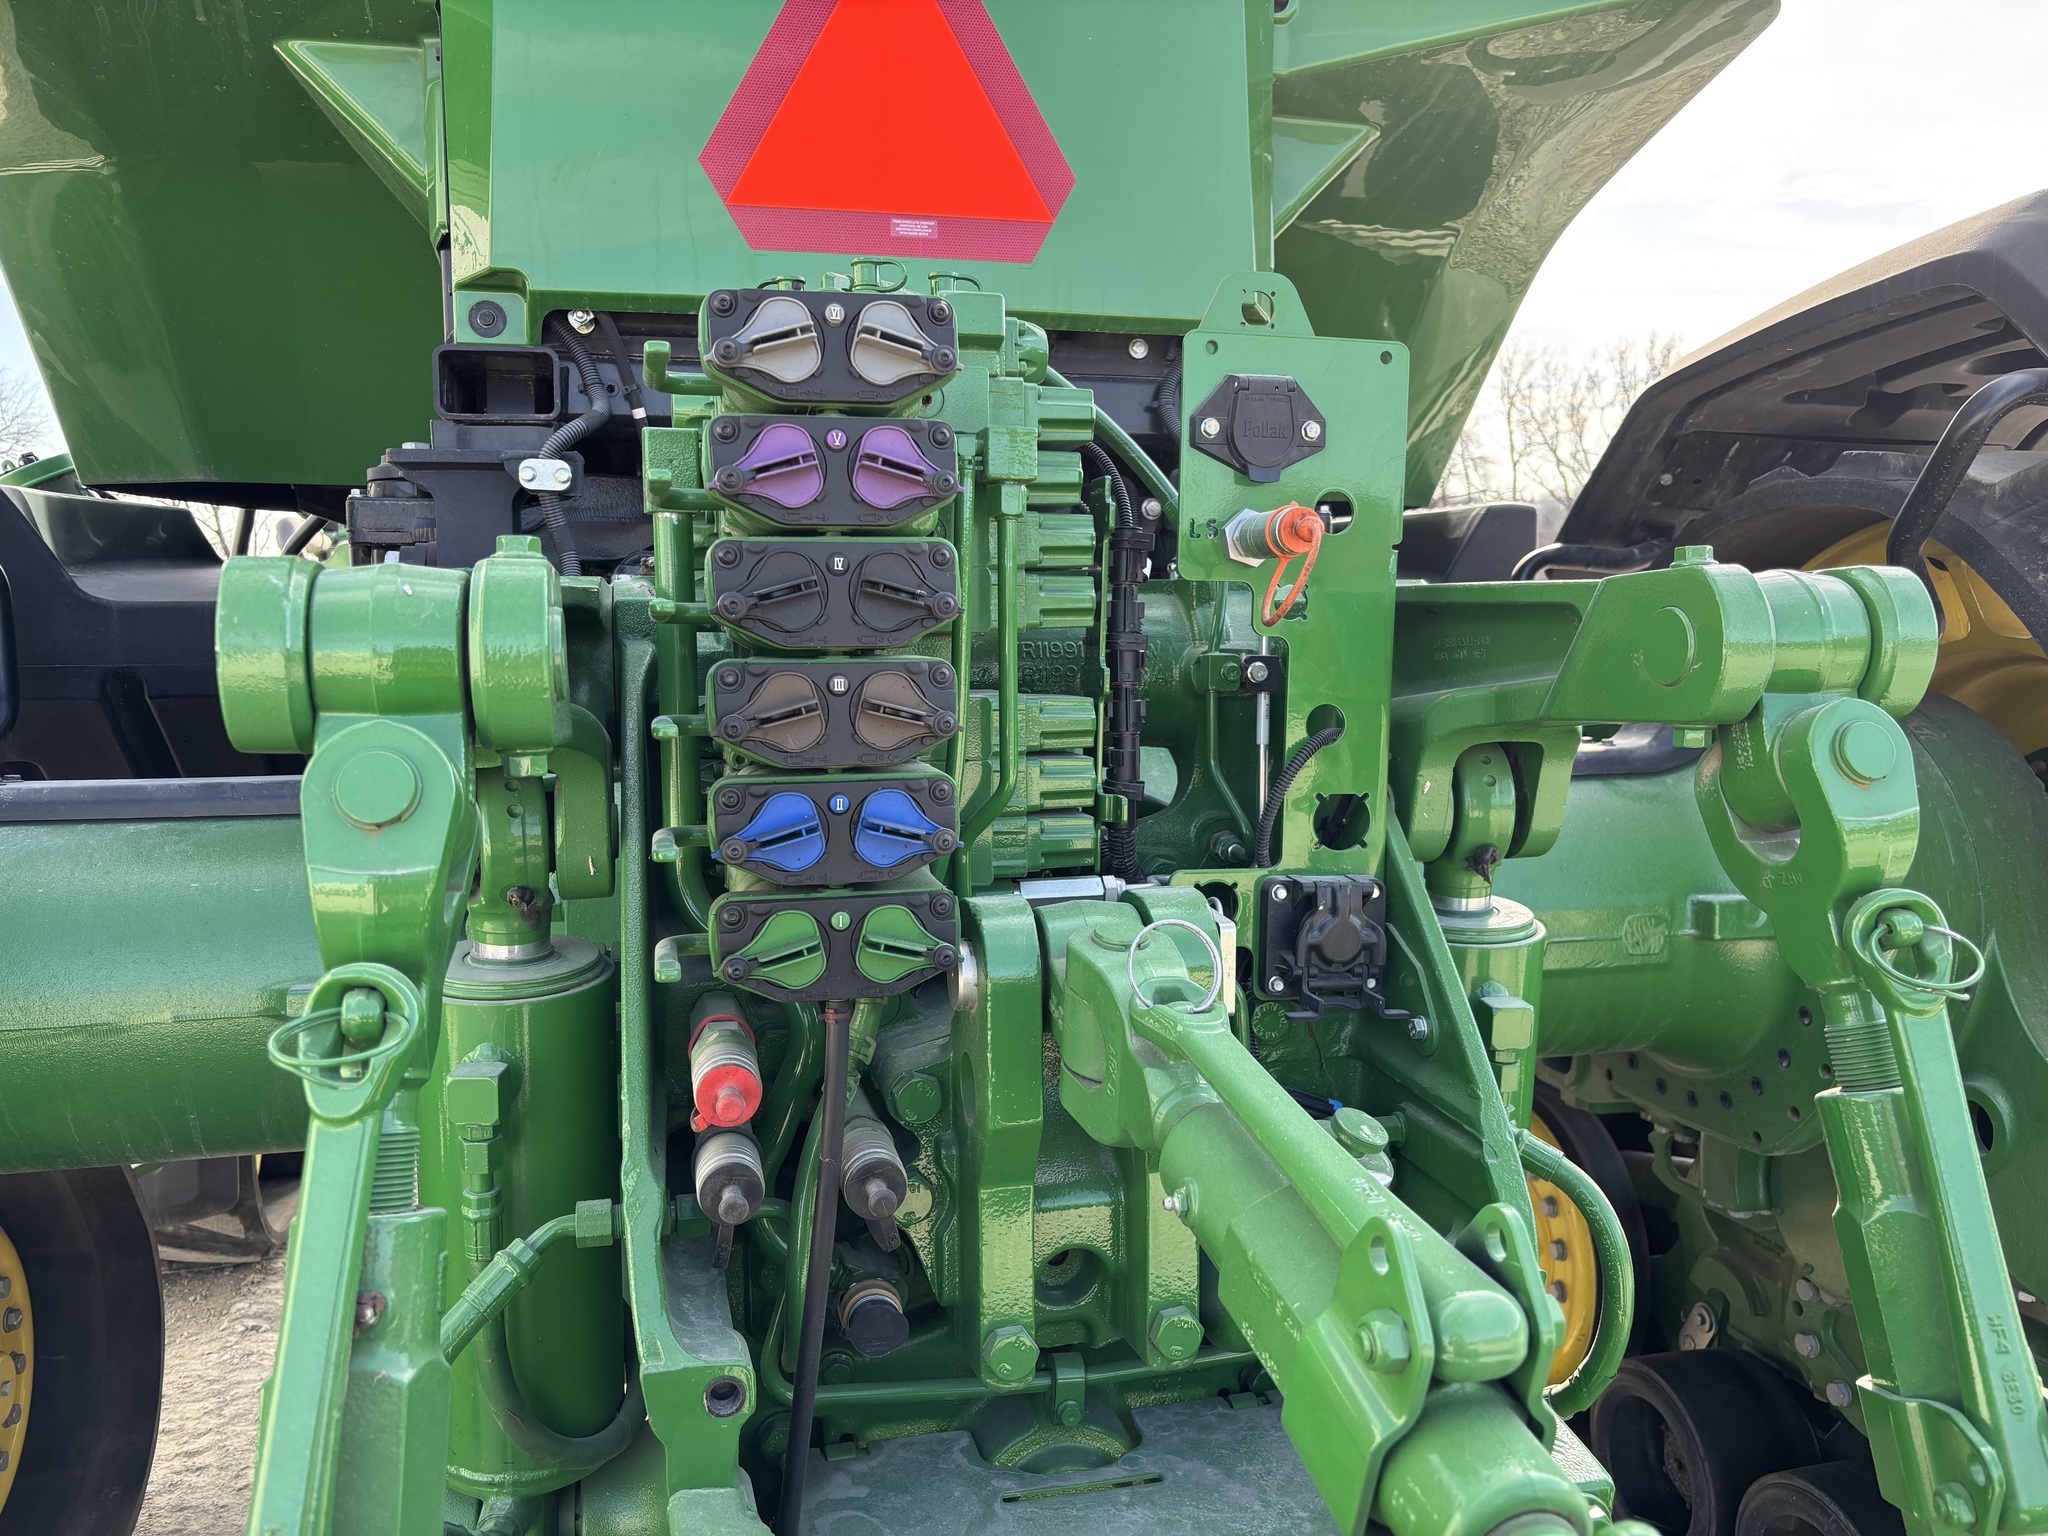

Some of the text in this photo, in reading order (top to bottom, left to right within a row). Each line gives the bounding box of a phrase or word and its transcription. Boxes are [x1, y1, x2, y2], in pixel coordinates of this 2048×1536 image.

[830, 306, 841, 320] VI
[1243, 420, 1288, 439] Pollak
[832, 432, 842, 446] V
[834, 557, 844, 571] IV
[833, 678, 845, 691] III
[836, 798, 844, 811] II
[838, 915, 844, 928] I
